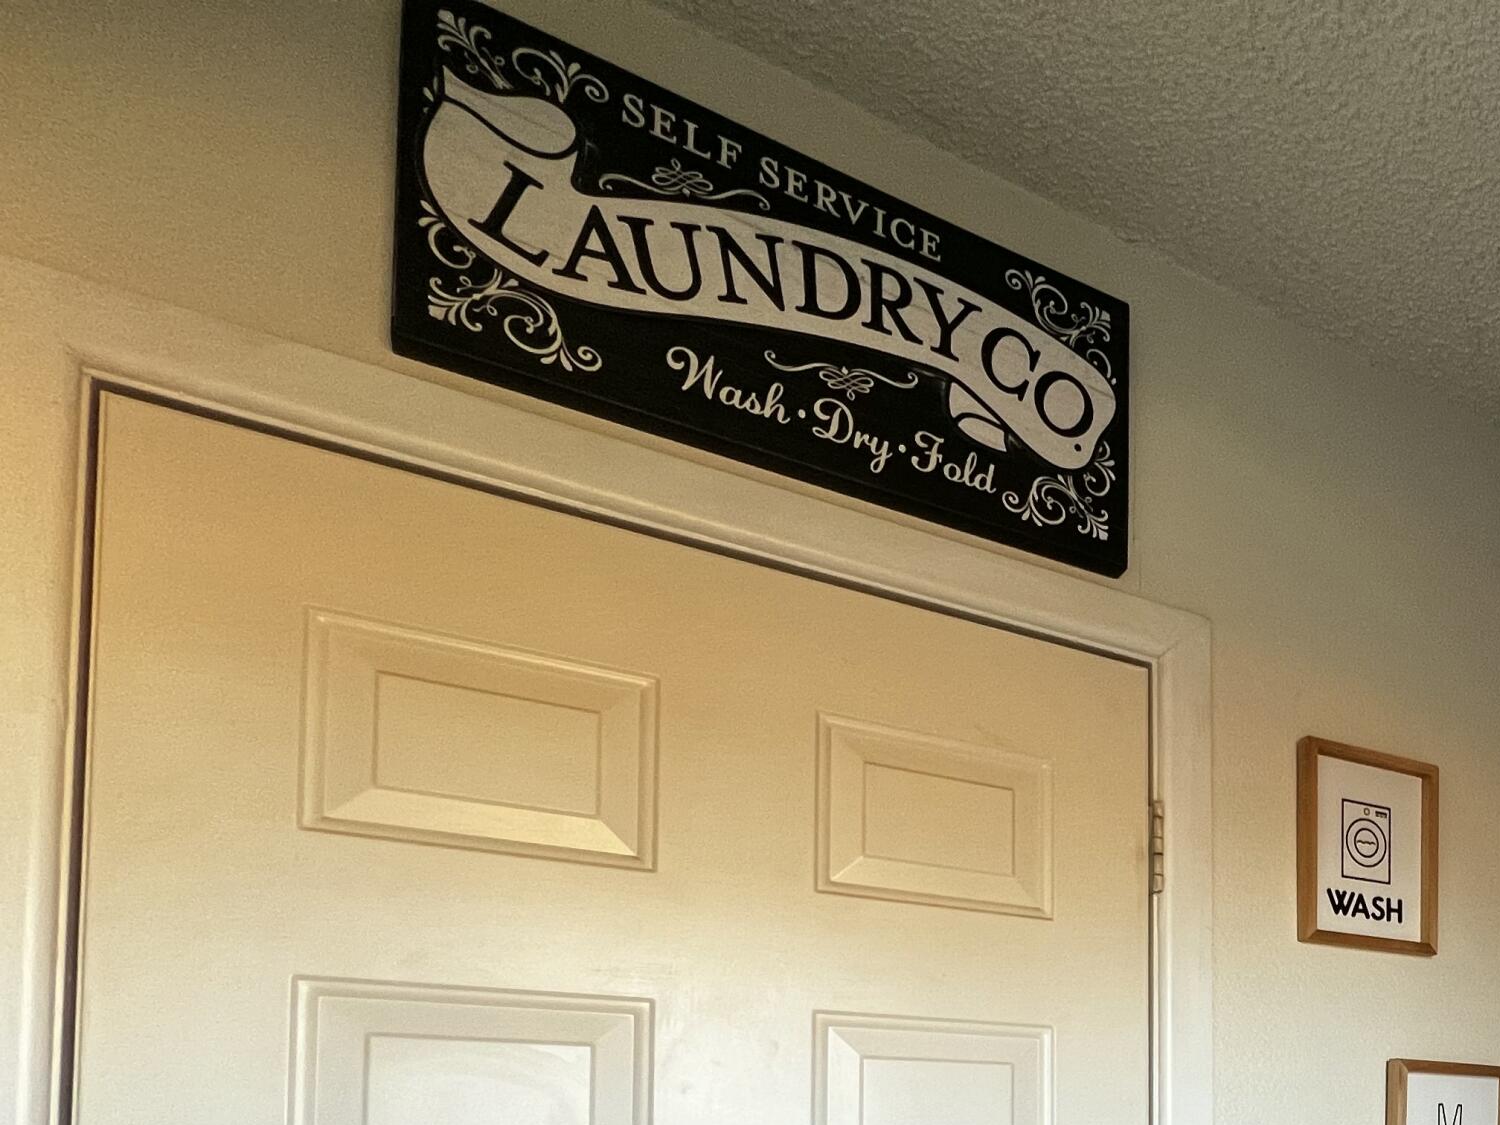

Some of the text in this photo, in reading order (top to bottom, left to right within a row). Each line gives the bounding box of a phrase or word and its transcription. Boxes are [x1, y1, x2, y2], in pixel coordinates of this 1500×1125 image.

[621, 93, 942, 262] SELF SERVICE
[469, 160, 1096, 438] LAUNDRY CO
[666, 346, 997, 494] Wash Dry Fold
[1326, 888, 1403, 925] WASH
